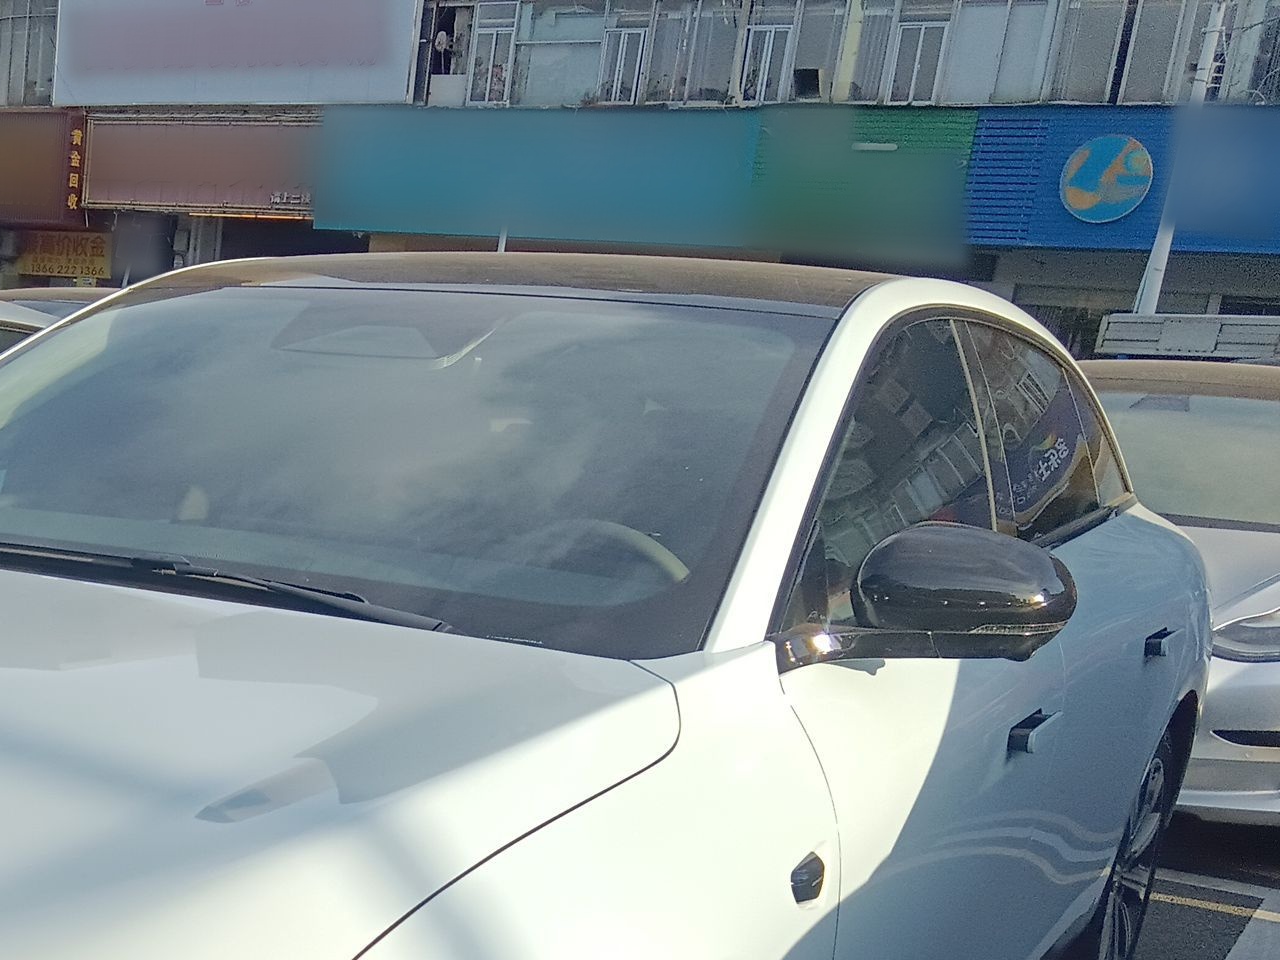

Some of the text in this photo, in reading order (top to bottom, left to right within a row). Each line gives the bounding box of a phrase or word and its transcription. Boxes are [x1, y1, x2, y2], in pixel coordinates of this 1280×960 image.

[67, 128, 83, 210] 黄金回收
[57, 265, 77, 275] 222
